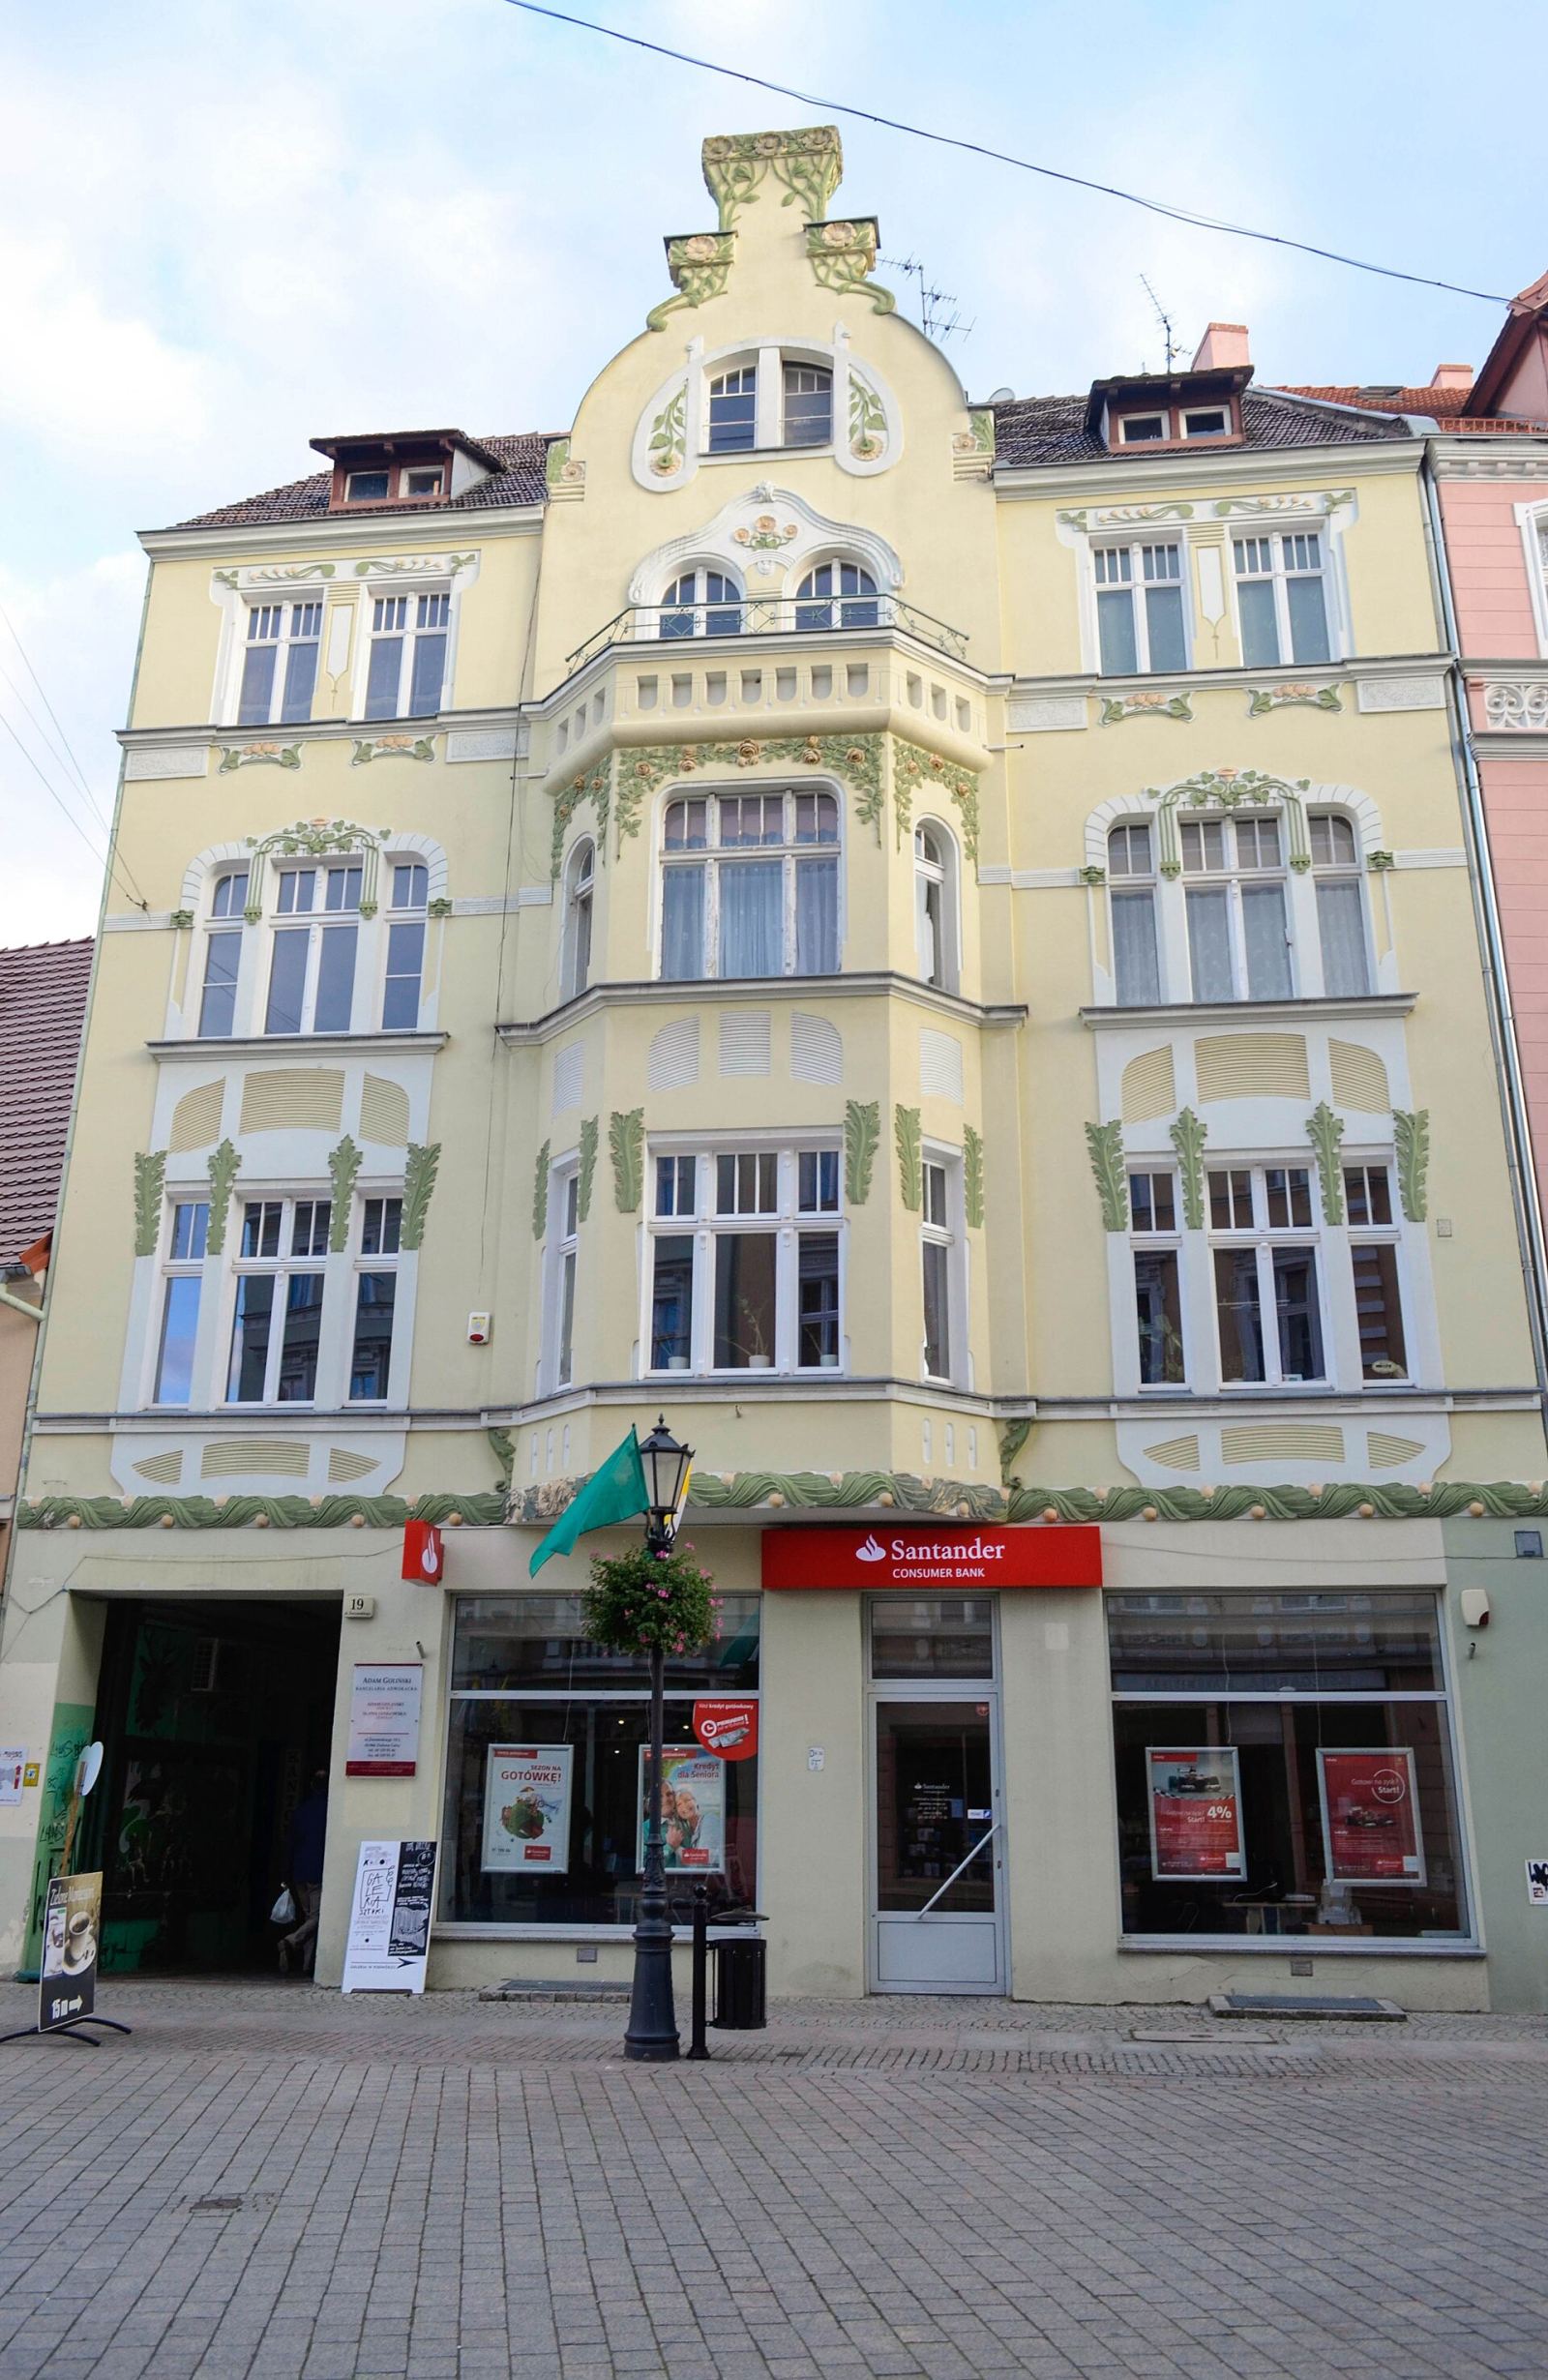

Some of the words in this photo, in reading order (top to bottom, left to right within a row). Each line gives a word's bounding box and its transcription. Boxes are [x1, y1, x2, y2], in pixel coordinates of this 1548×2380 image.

[891, 1536, 1005, 1561] Santander
[892, 1567, 953, 1579] CONSUMER
[955, 1567, 985, 1578] BANK
[351, 1597, 364, 1611] 19
[694, 1762, 720, 1771] Kredyt
[501, 1770, 561, 1784] GOTÓWKĘ!
[1206, 1805, 1233, 1819] 4%
